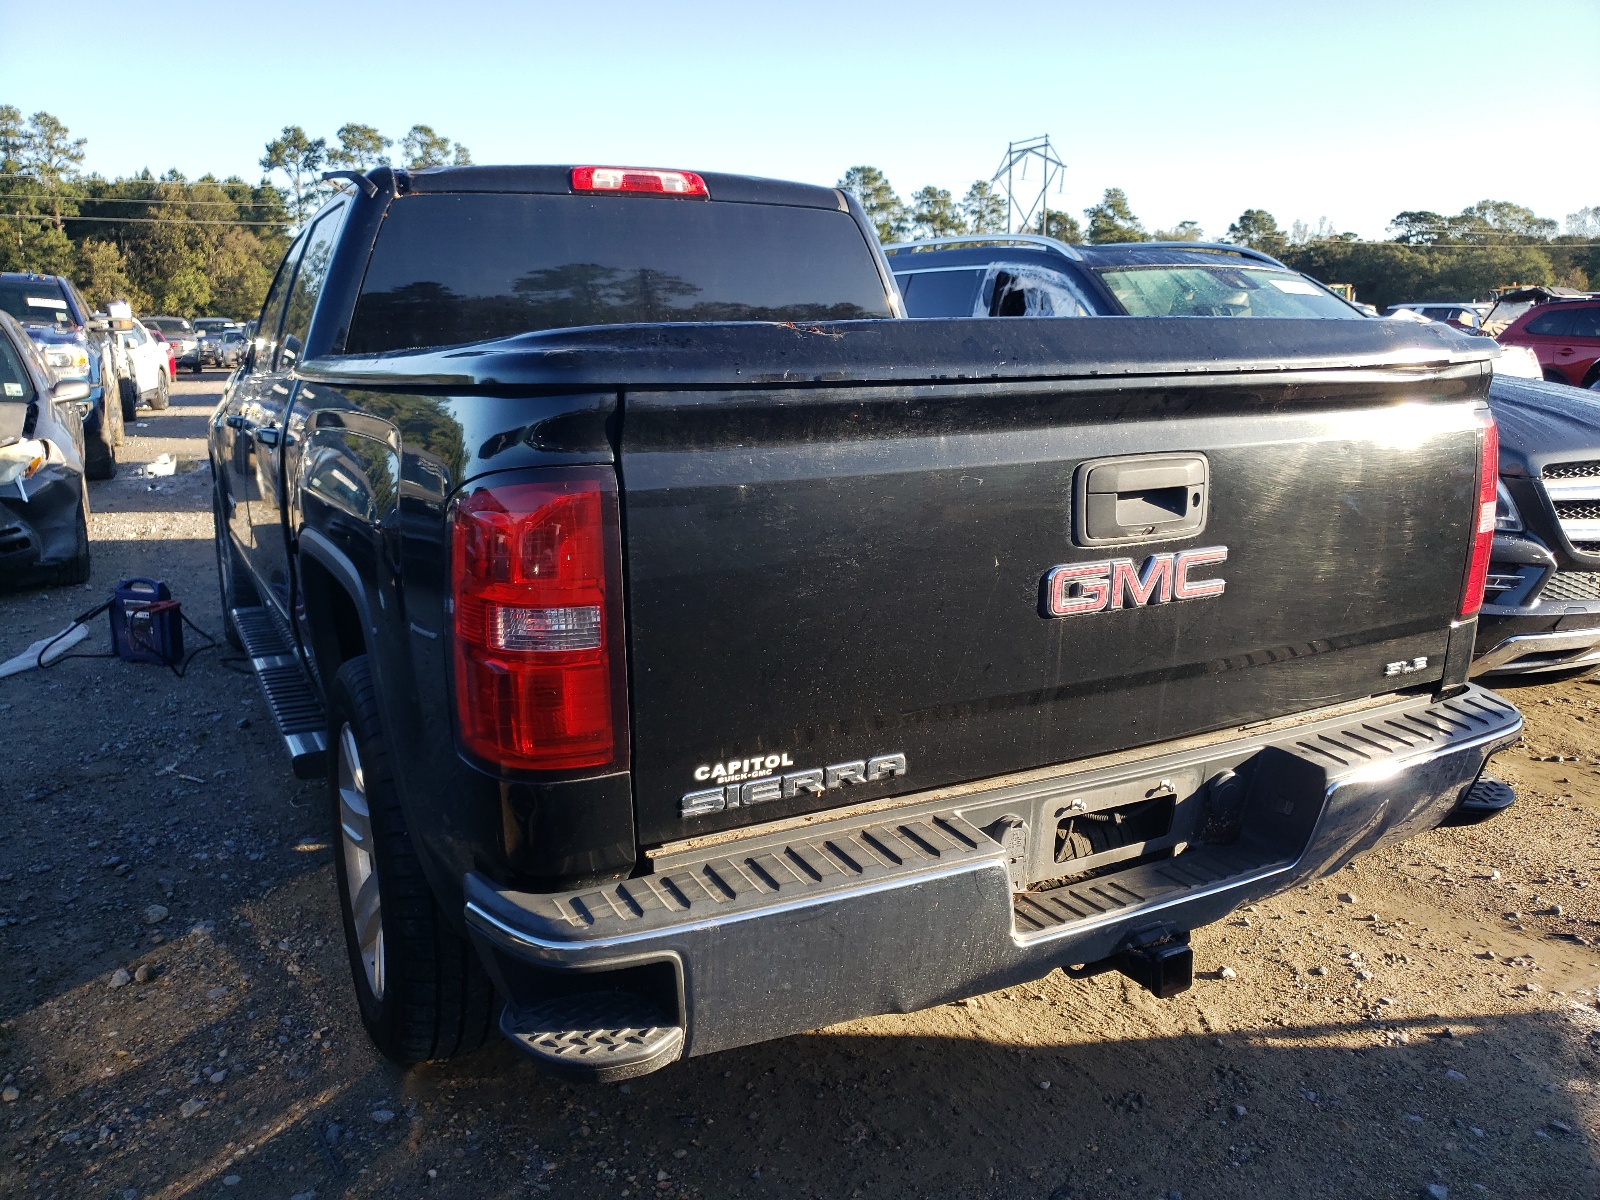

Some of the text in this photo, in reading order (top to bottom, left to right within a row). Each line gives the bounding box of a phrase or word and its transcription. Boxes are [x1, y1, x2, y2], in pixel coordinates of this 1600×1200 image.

[1047, 546, 1229, 617] GMC
[1384, 656, 1428, 676] SLE
[680, 753, 906, 818] SIERRA
[694, 753, 794, 781] CAPITOL
